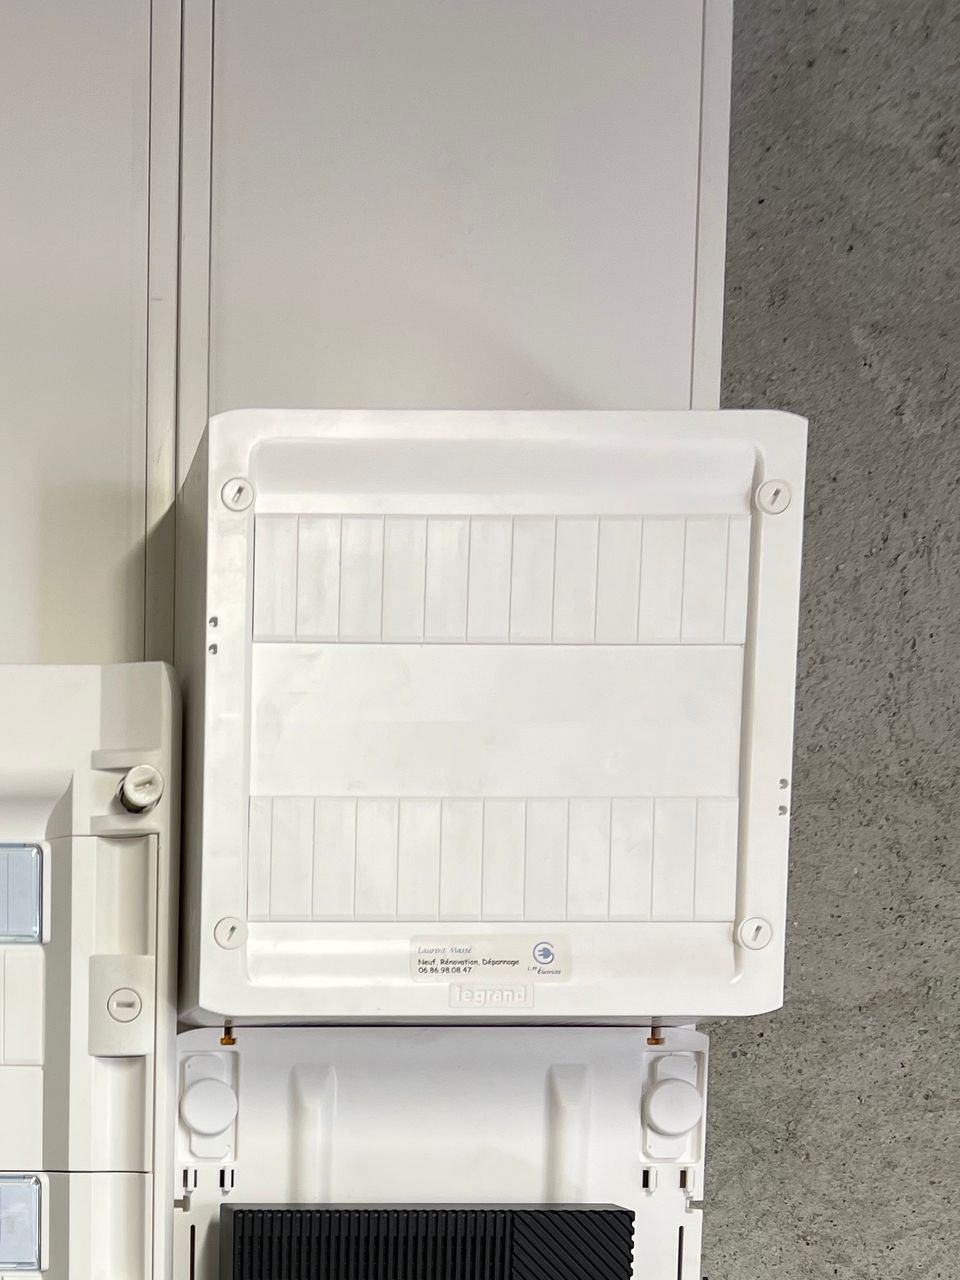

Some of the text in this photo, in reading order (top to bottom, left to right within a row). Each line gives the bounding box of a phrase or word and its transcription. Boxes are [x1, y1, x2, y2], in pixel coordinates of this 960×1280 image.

[418, 947, 446, 956] Laurent
[440, 959, 480, 967] Rénovation,
[456, 985, 526, 1006] legrand
